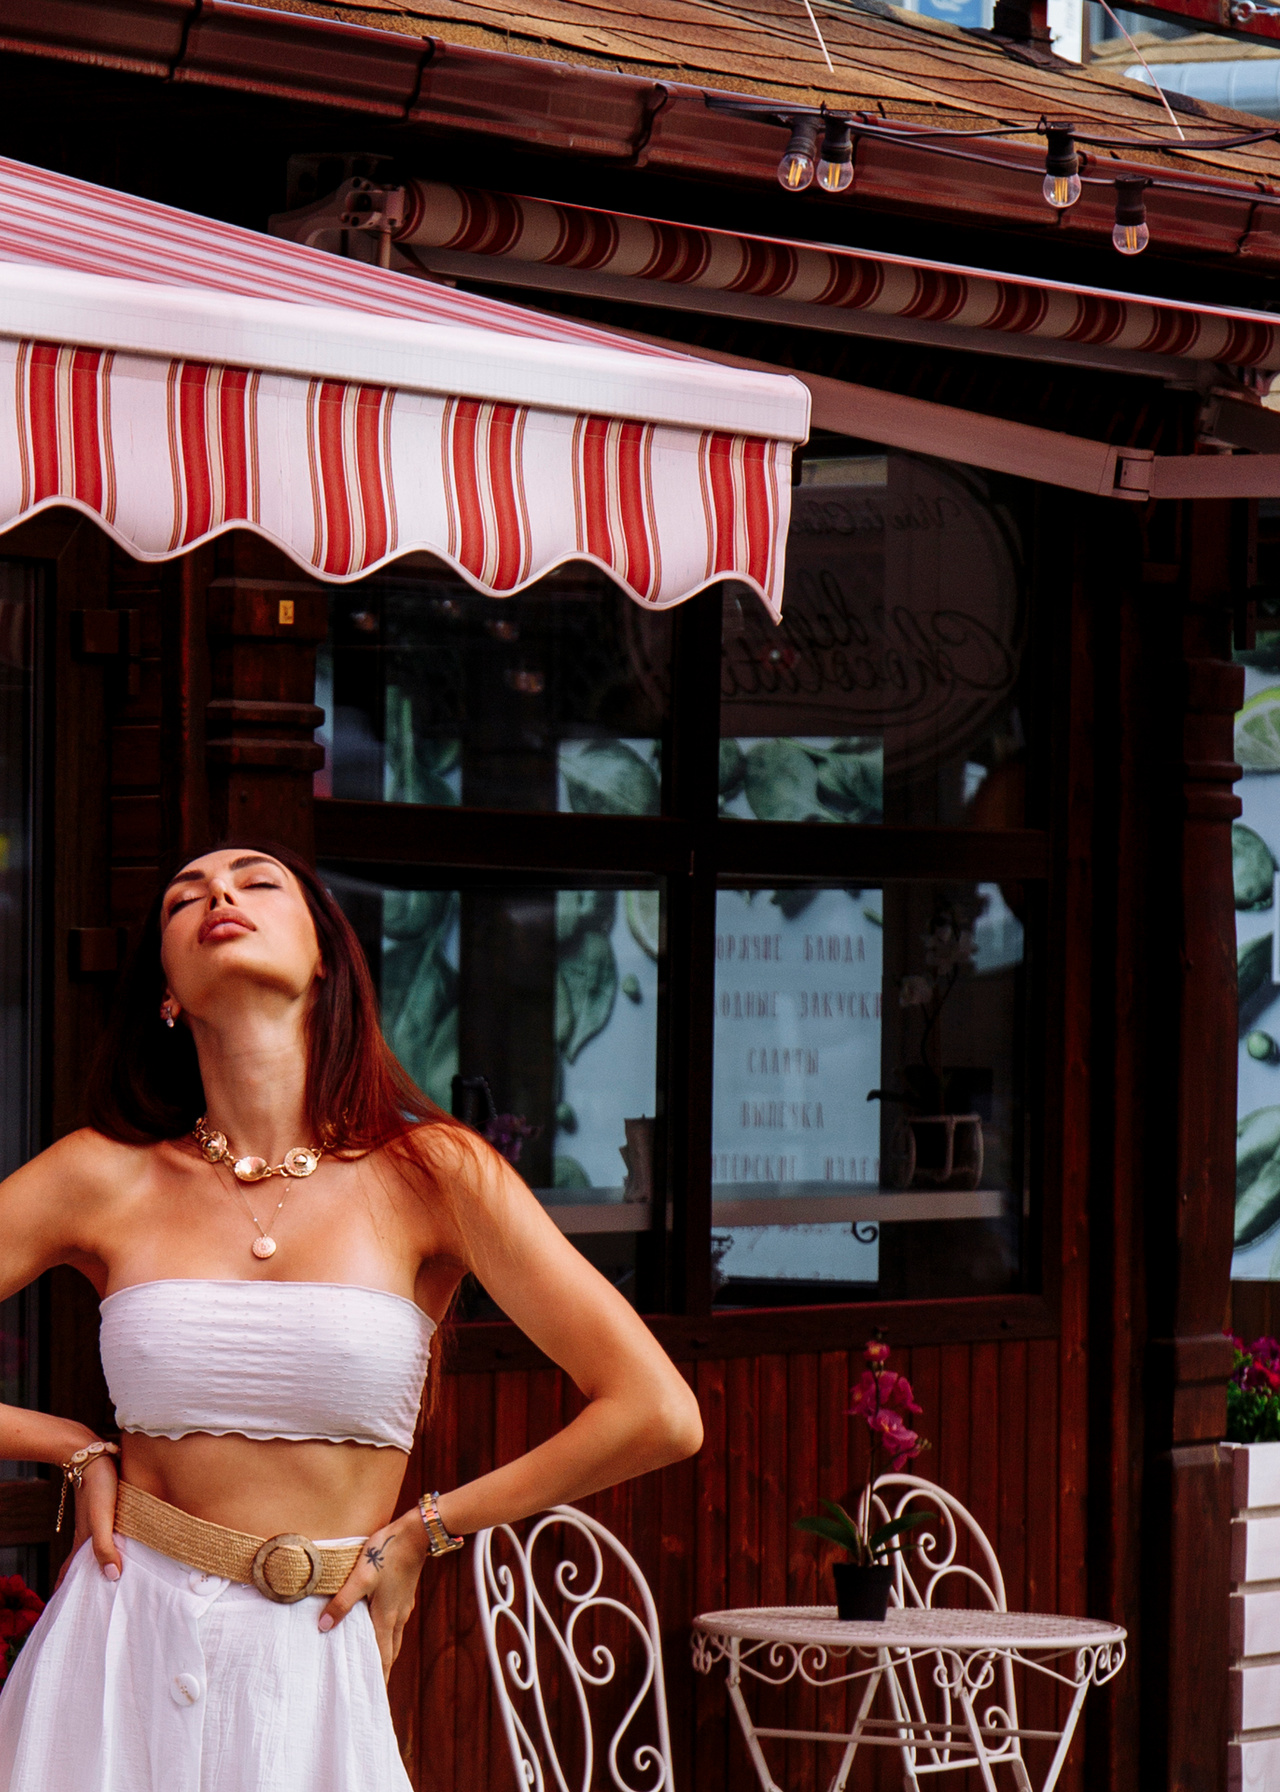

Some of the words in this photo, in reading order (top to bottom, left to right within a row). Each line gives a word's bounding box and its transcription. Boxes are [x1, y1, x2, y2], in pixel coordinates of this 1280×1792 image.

[716, 934, 781, 961] ОРЯЧИЕ
[804, 934, 866, 962] БЛЮДА
[716, 991, 778, 1018] ОДНЫЕ
